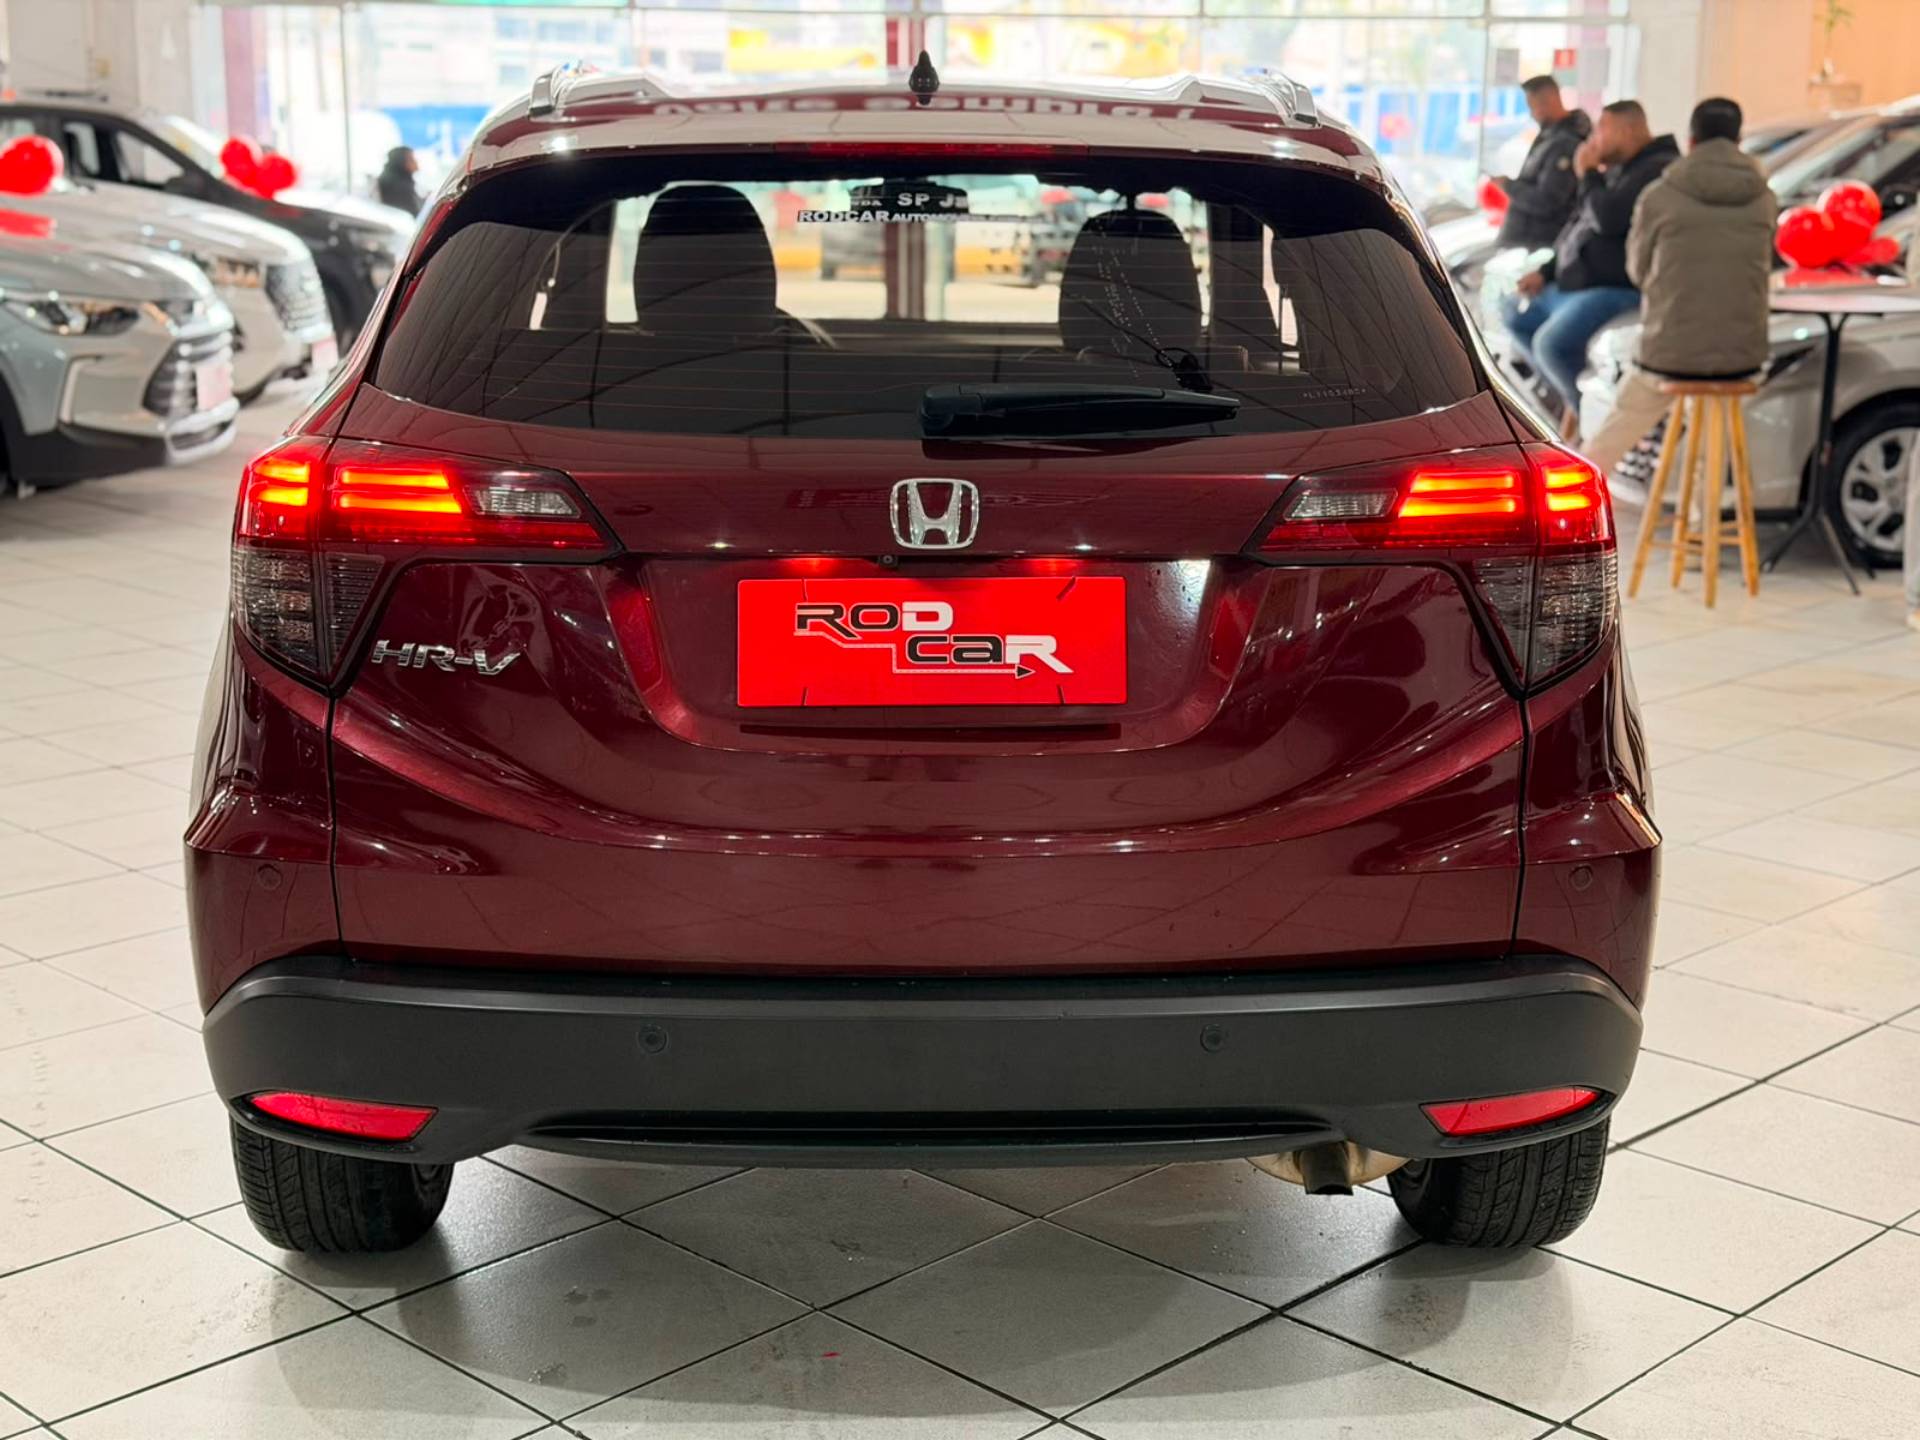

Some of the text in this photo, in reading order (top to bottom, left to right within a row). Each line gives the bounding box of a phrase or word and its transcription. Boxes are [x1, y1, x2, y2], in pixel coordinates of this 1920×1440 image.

[897, 192, 931, 207] SP
[798, 210, 890, 222] RODCAR
[371, 639, 521, 675] HR-V
